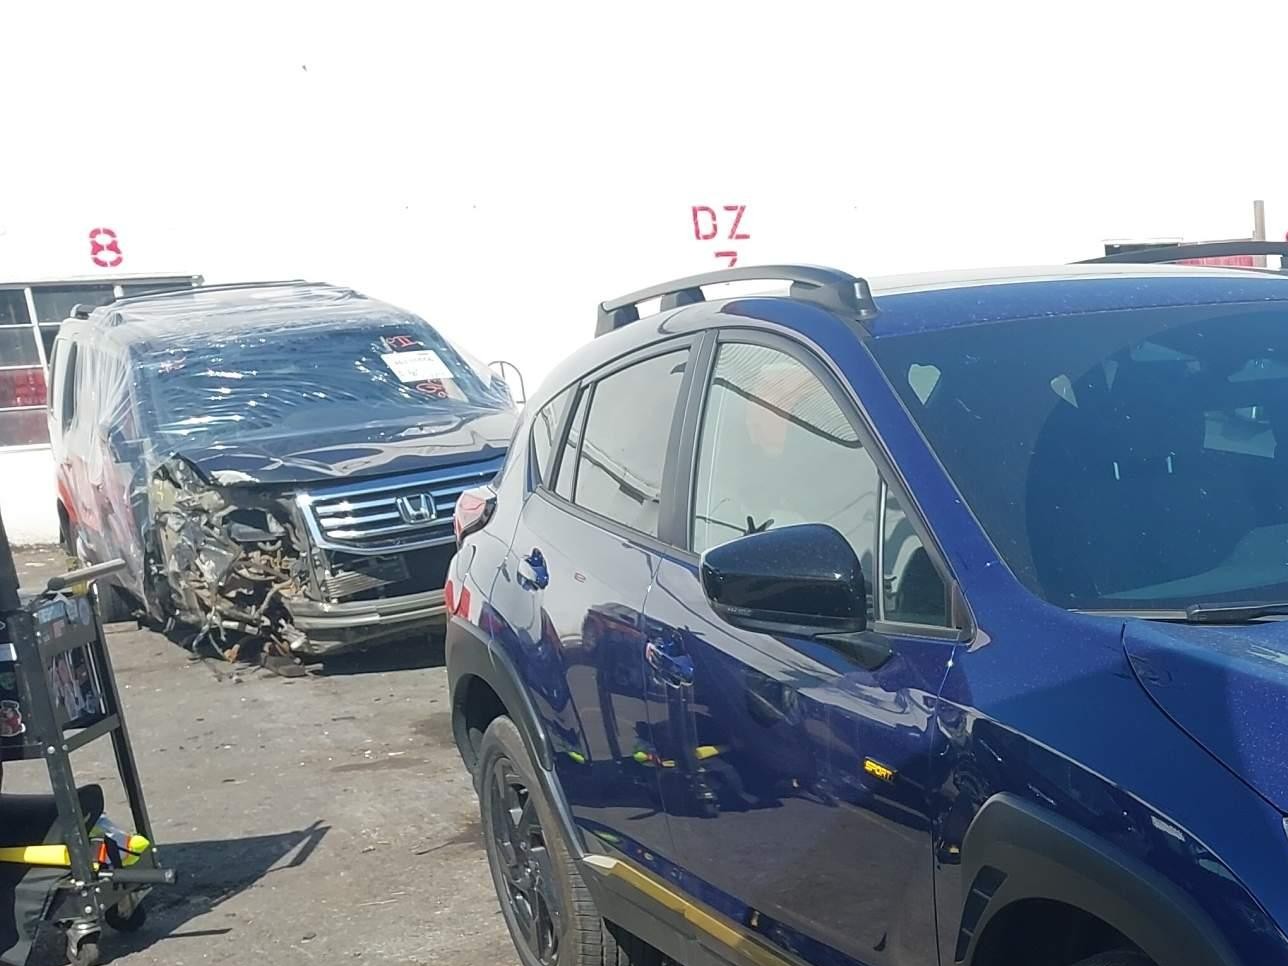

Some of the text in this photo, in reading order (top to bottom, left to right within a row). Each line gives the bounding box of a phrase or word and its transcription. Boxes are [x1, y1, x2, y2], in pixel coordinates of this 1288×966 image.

[691, 205, 751, 241] DZ
[89, 227, 123, 268] 8
[864, 760, 894, 781] SPORT
